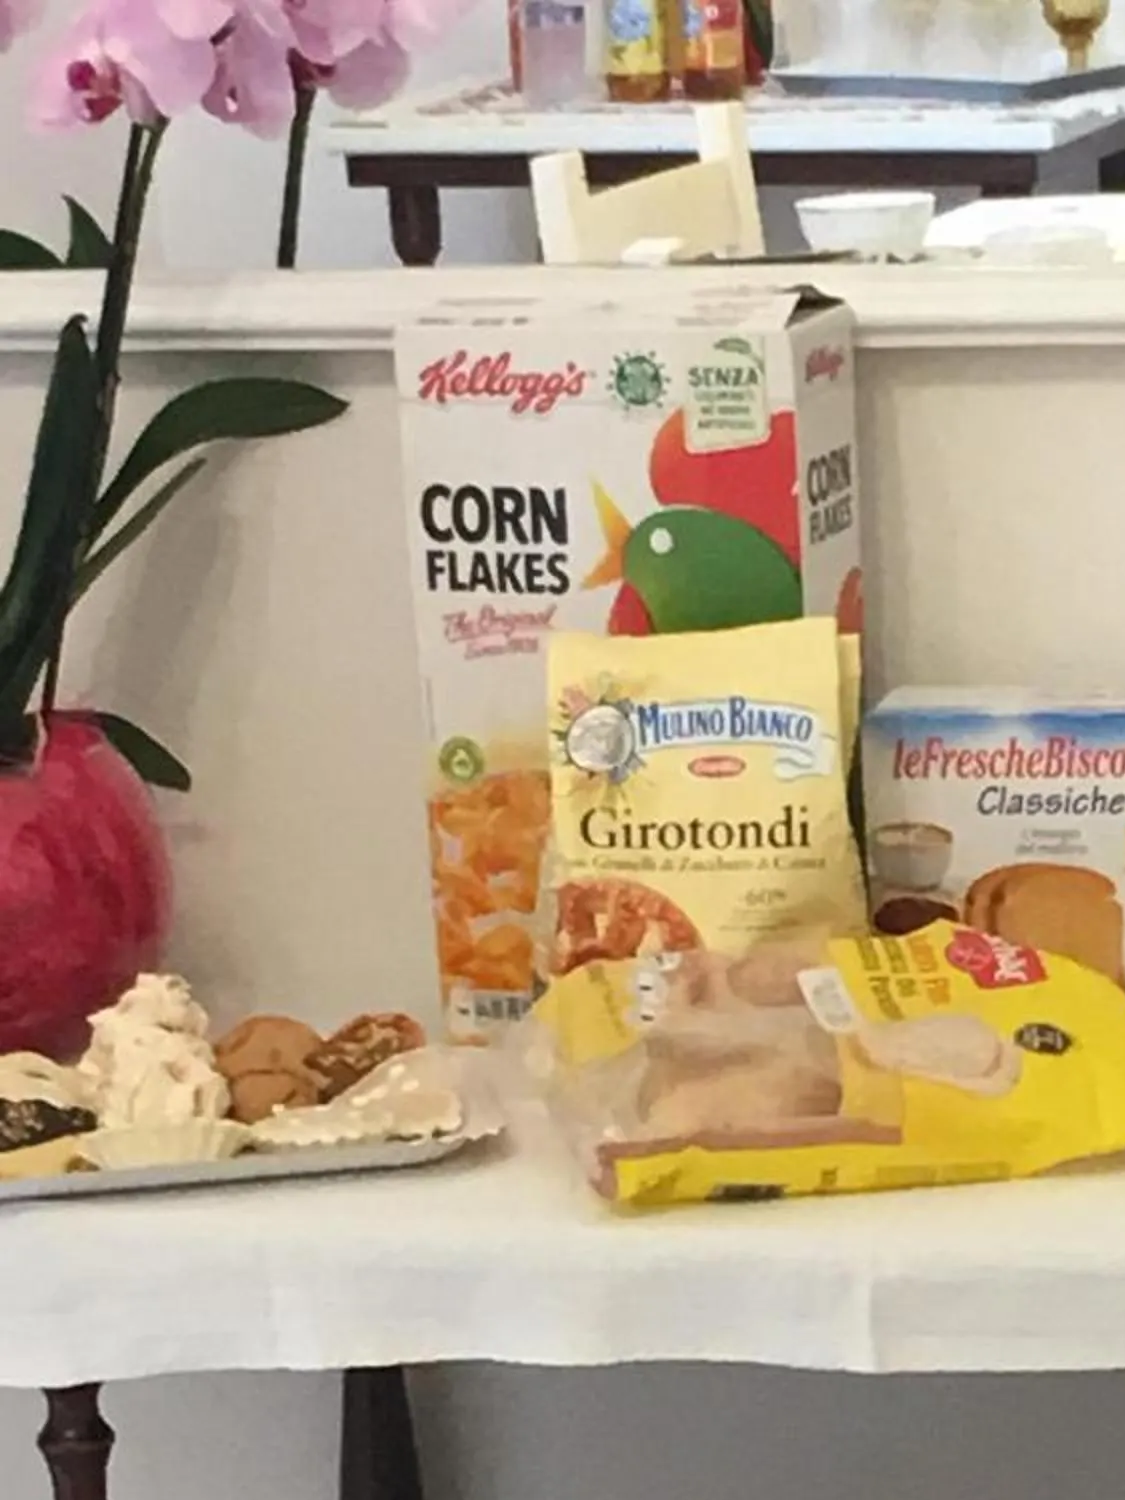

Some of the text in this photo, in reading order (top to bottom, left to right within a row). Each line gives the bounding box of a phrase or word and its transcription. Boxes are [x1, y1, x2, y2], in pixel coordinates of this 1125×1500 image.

[417, 349, 586, 414] Kellogg's
[687, 366, 760, 388] SENZA
[807, 443, 852, 506] CORN
[420, 483, 569, 544] CORN
[426, 551, 570, 595] FLAKES
[637, 696, 813, 745] MULINO BIANCO
[579, 805, 811, 851] Girotondi
